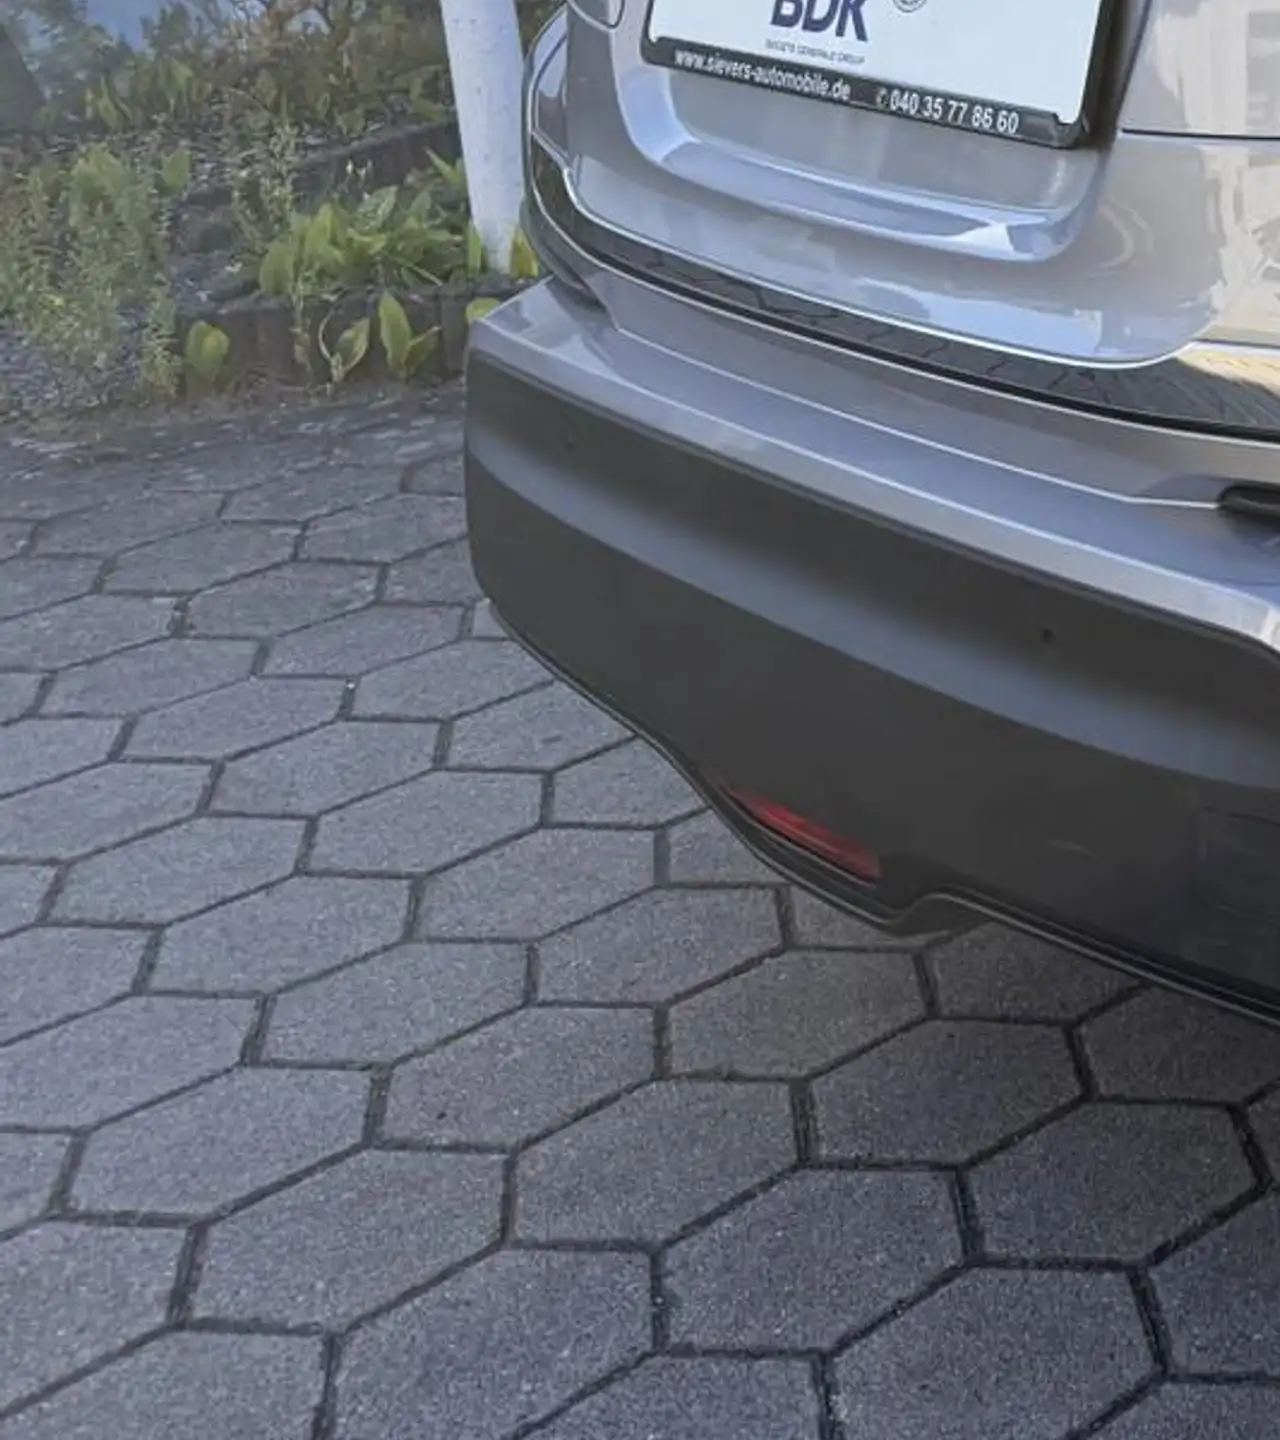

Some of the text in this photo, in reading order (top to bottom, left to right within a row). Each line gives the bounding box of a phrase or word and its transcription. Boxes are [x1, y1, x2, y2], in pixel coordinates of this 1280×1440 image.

[674, 49, 851, 100] www.sievers-automobile.de
[889, 89, 920, 116] 040
[922, 95, 945, 120] 35
[948, 100, 968, 125] 77
[971, 104, 993, 129] 86
[996, 110, 1019, 135] 60
